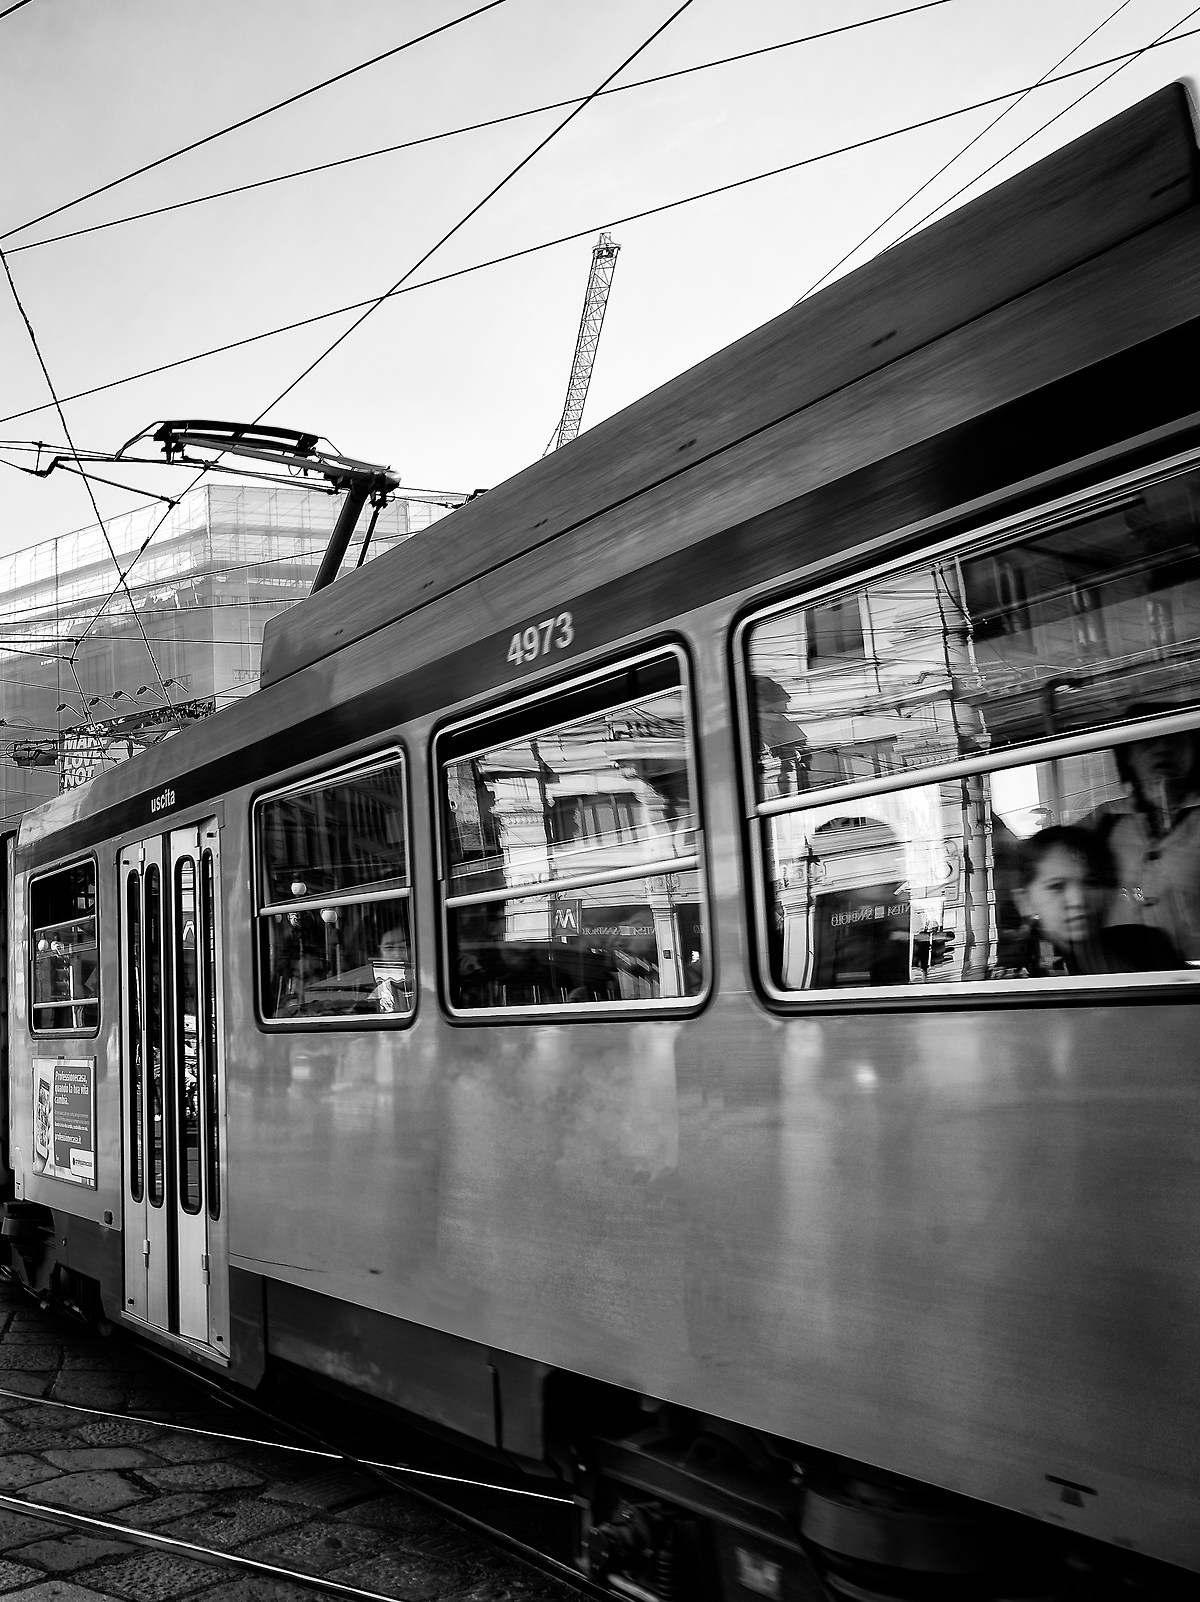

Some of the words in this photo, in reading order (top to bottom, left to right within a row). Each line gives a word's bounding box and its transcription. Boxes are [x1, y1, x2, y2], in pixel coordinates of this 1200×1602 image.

[506, 611, 575, 666] 4973
[63, 747, 103, 770] LOVE
[64, 766, 95, 788] NOT
[151, 788, 176, 813] uscita
